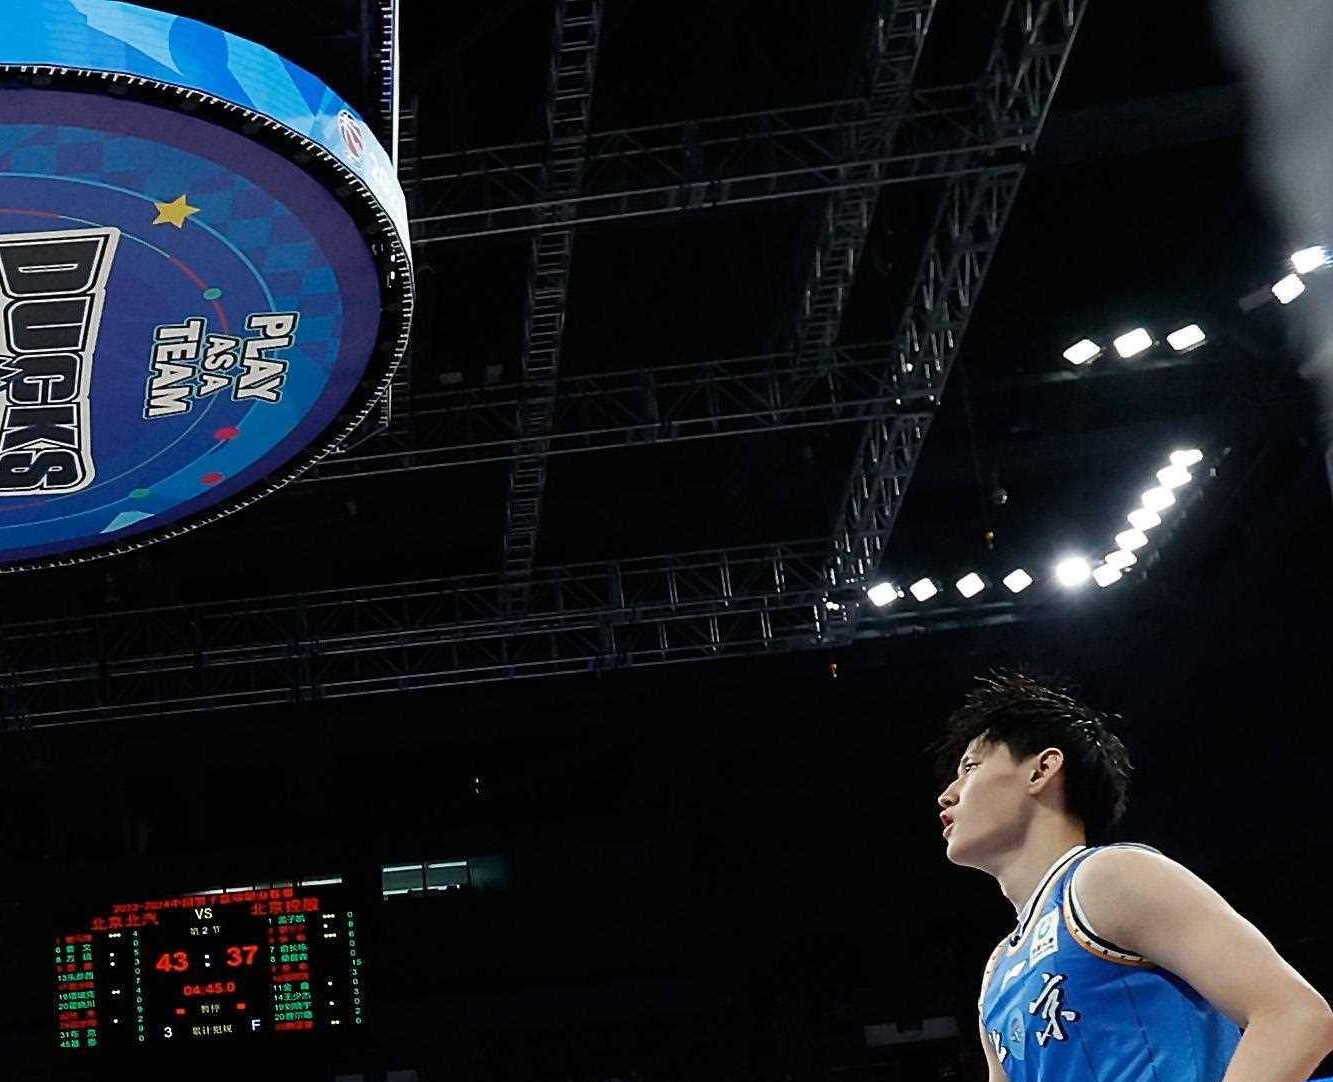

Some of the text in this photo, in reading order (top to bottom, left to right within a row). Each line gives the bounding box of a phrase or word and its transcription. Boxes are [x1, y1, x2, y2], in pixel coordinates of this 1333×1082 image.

[233, 311, 297, 402] PLAY
[144, 319, 205, 419] TEAM
[195, 908, 213, 919] VS
[156, 945, 259, 972] 43 37
[164, 1026, 173, 1038] 3
[252, 1020, 261, 1031] F
